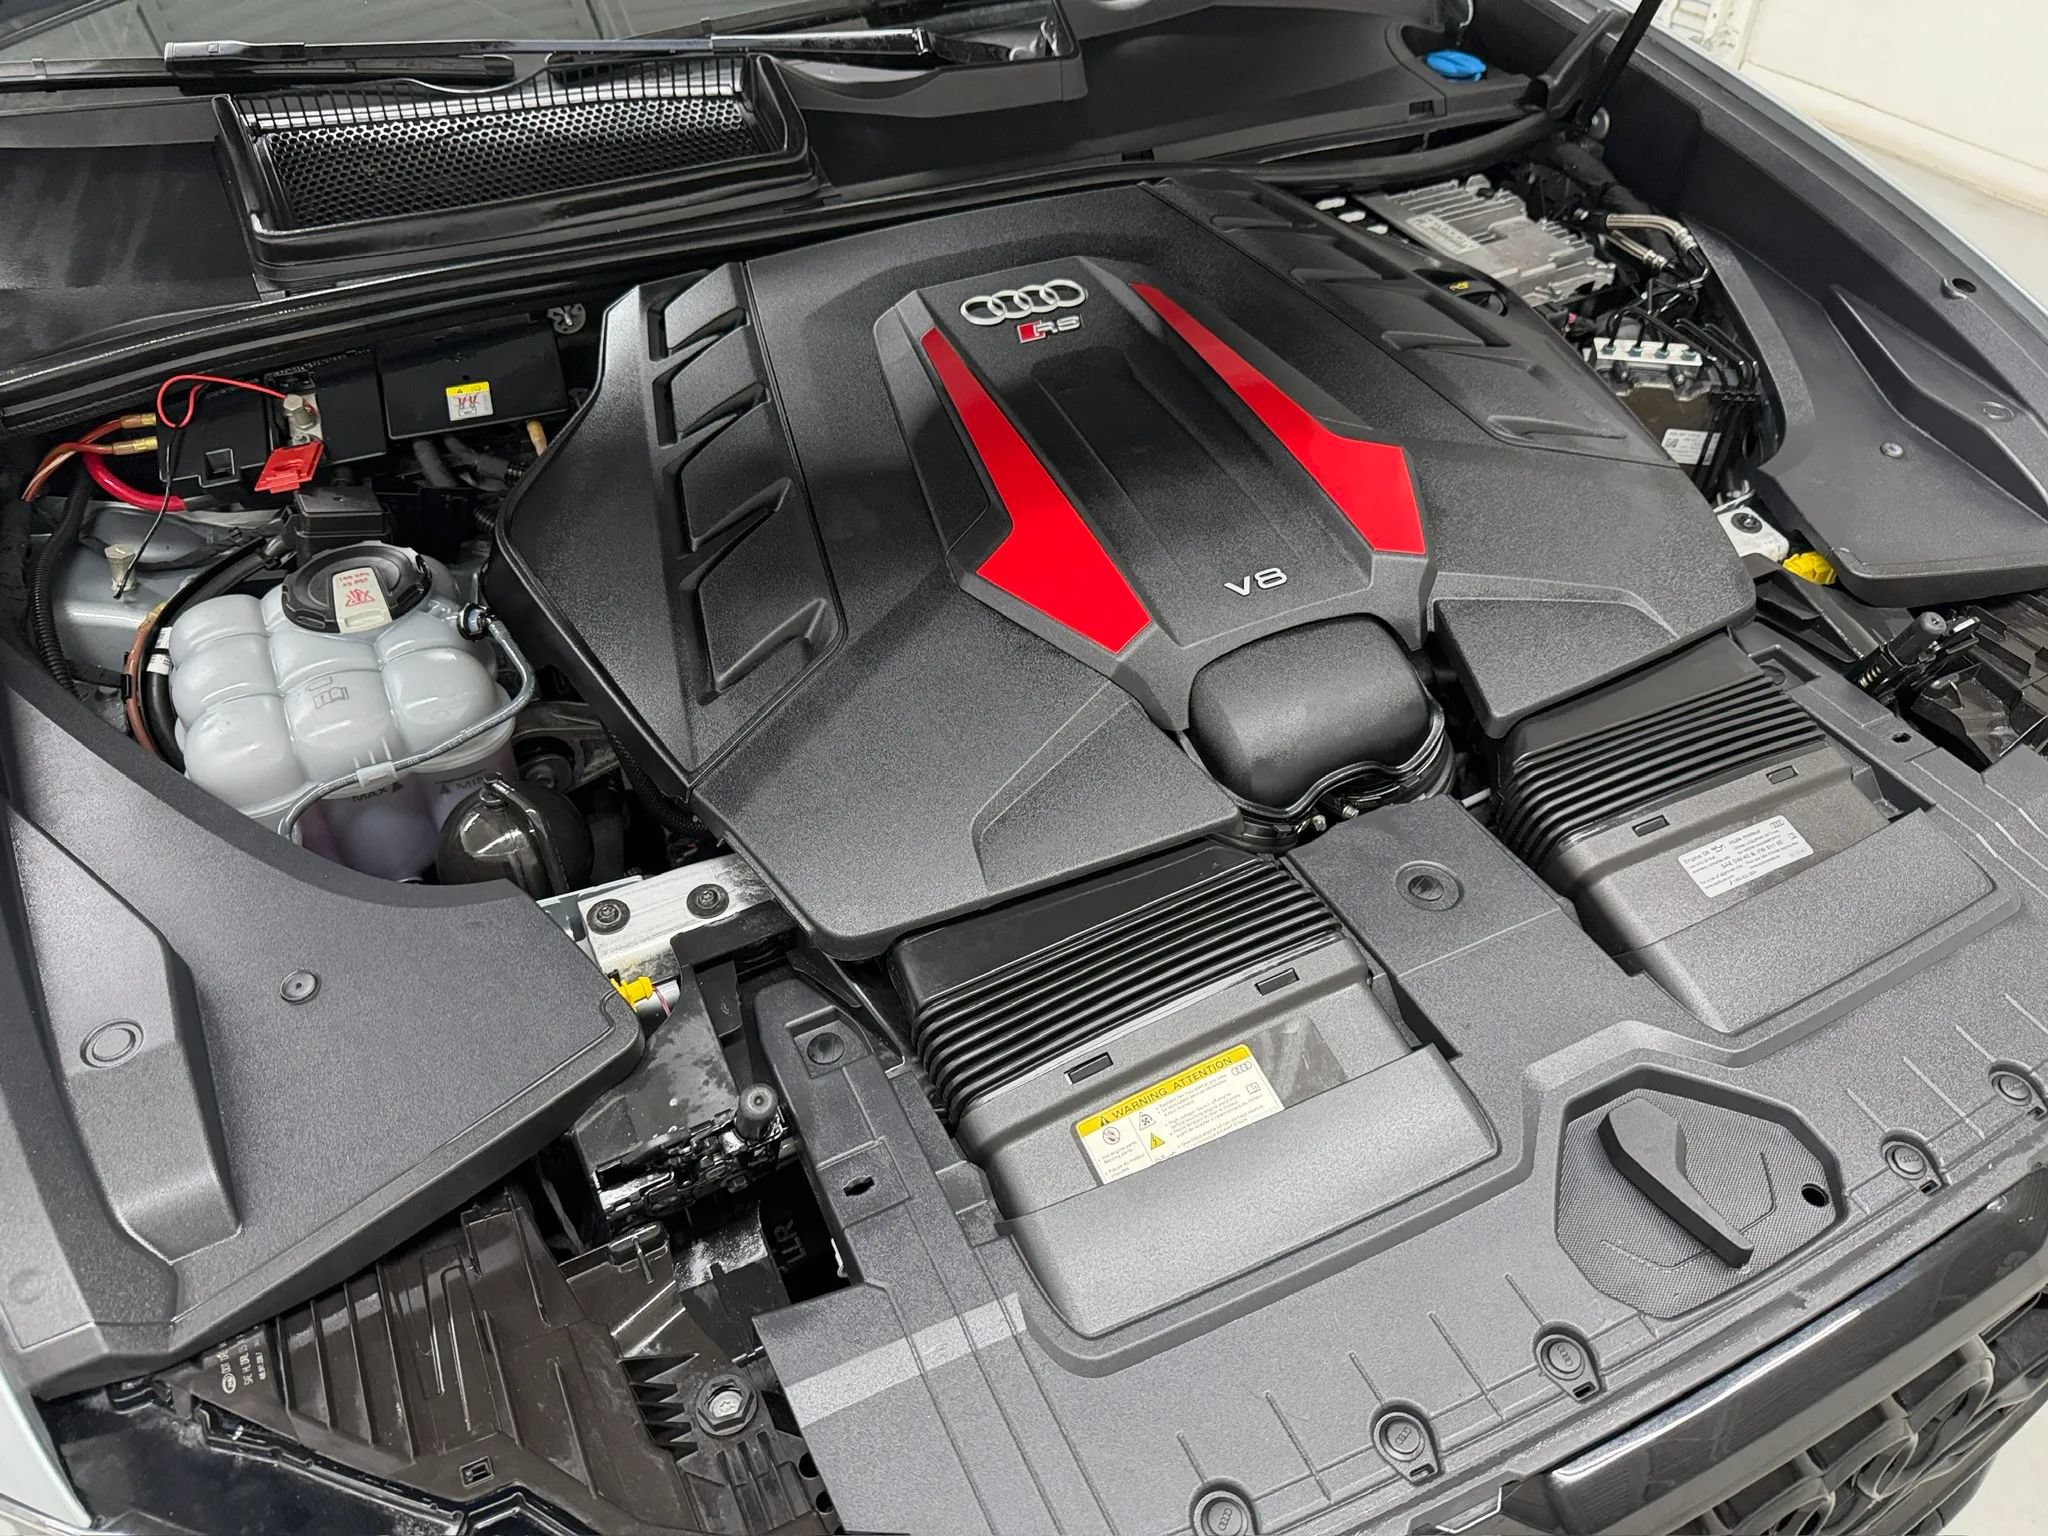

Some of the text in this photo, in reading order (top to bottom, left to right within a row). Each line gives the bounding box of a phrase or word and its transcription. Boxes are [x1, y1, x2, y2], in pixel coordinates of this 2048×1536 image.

[1026, 315, 1080, 340] RS
[1223, 567, 1287, 596] V8
[1112, 1087, 1168, 1119] WARNING
[1172, 1056, 1233, 1090] ATTENTION
